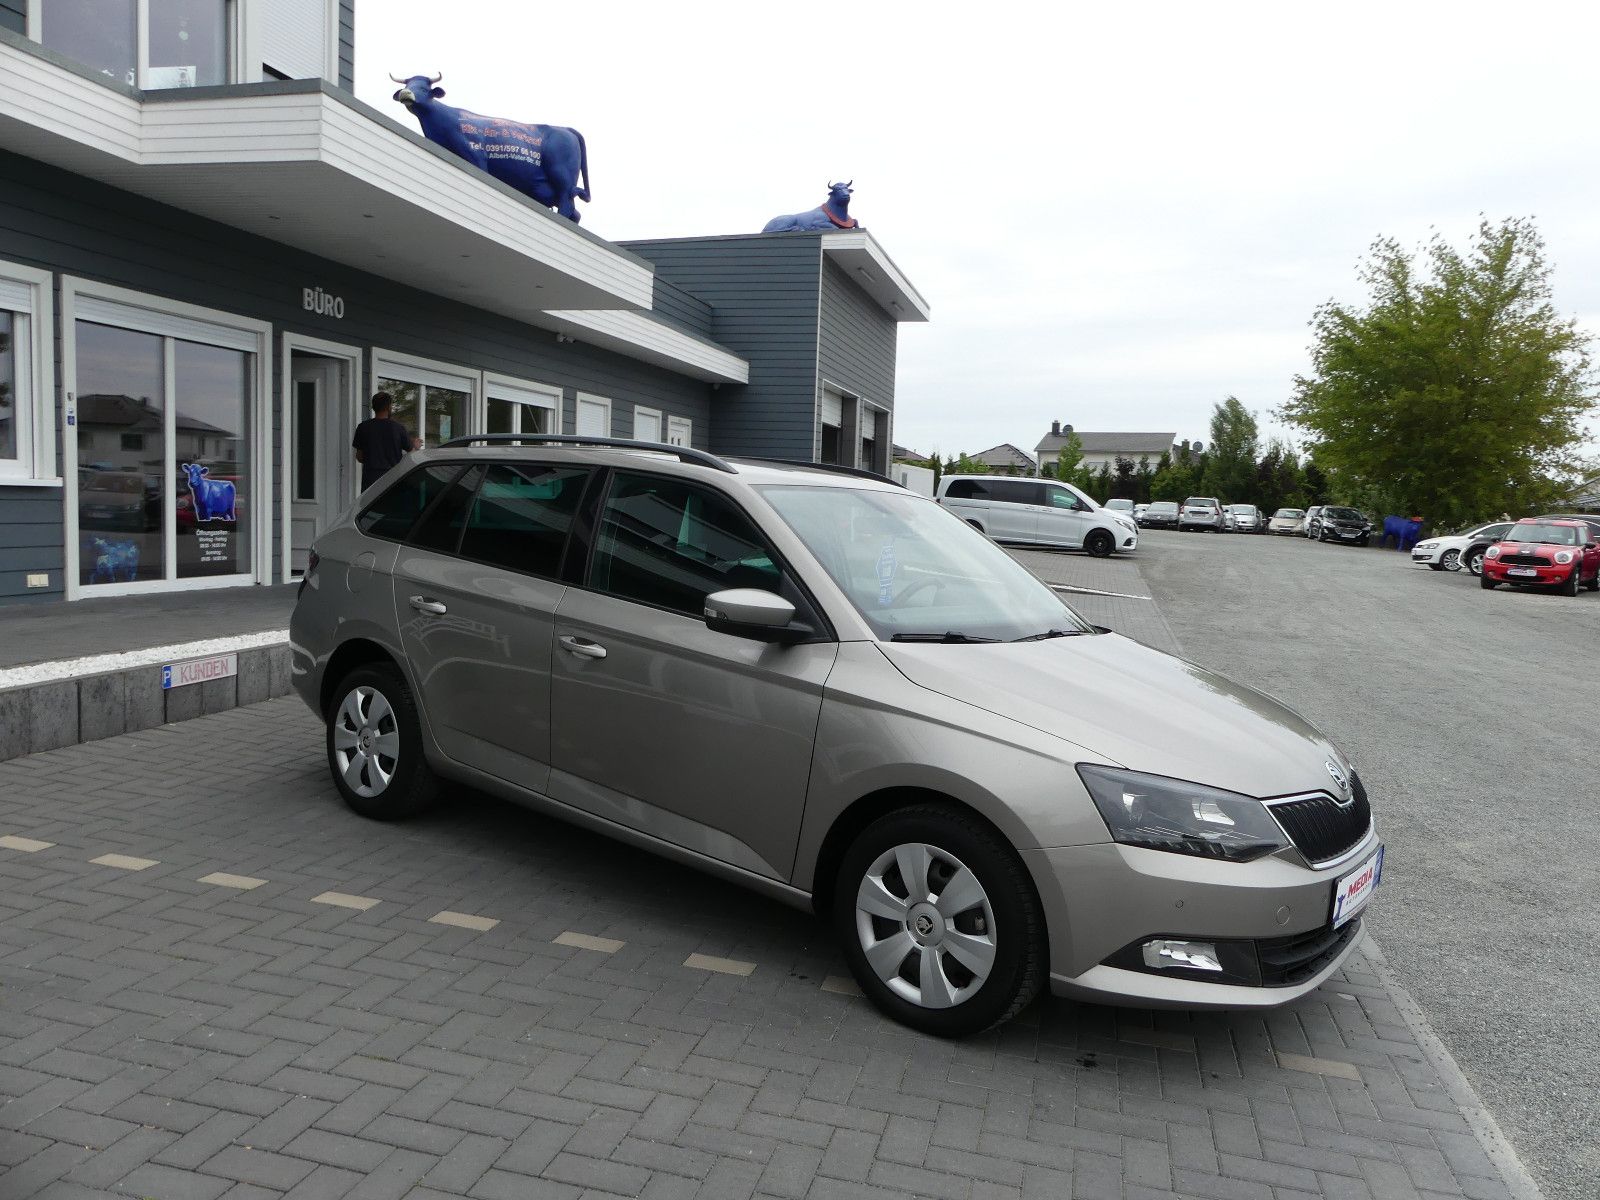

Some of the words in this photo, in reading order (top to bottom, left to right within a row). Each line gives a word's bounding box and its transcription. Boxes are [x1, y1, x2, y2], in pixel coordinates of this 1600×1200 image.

[469, 141, 484, 150] Tel.
[303, 286, 344, 319] BÜRO
[164, 671, 170, 685] P
[180, 657, 229, 683] KUNDEN
[1347, 867, 1373, 898] MEDIA
